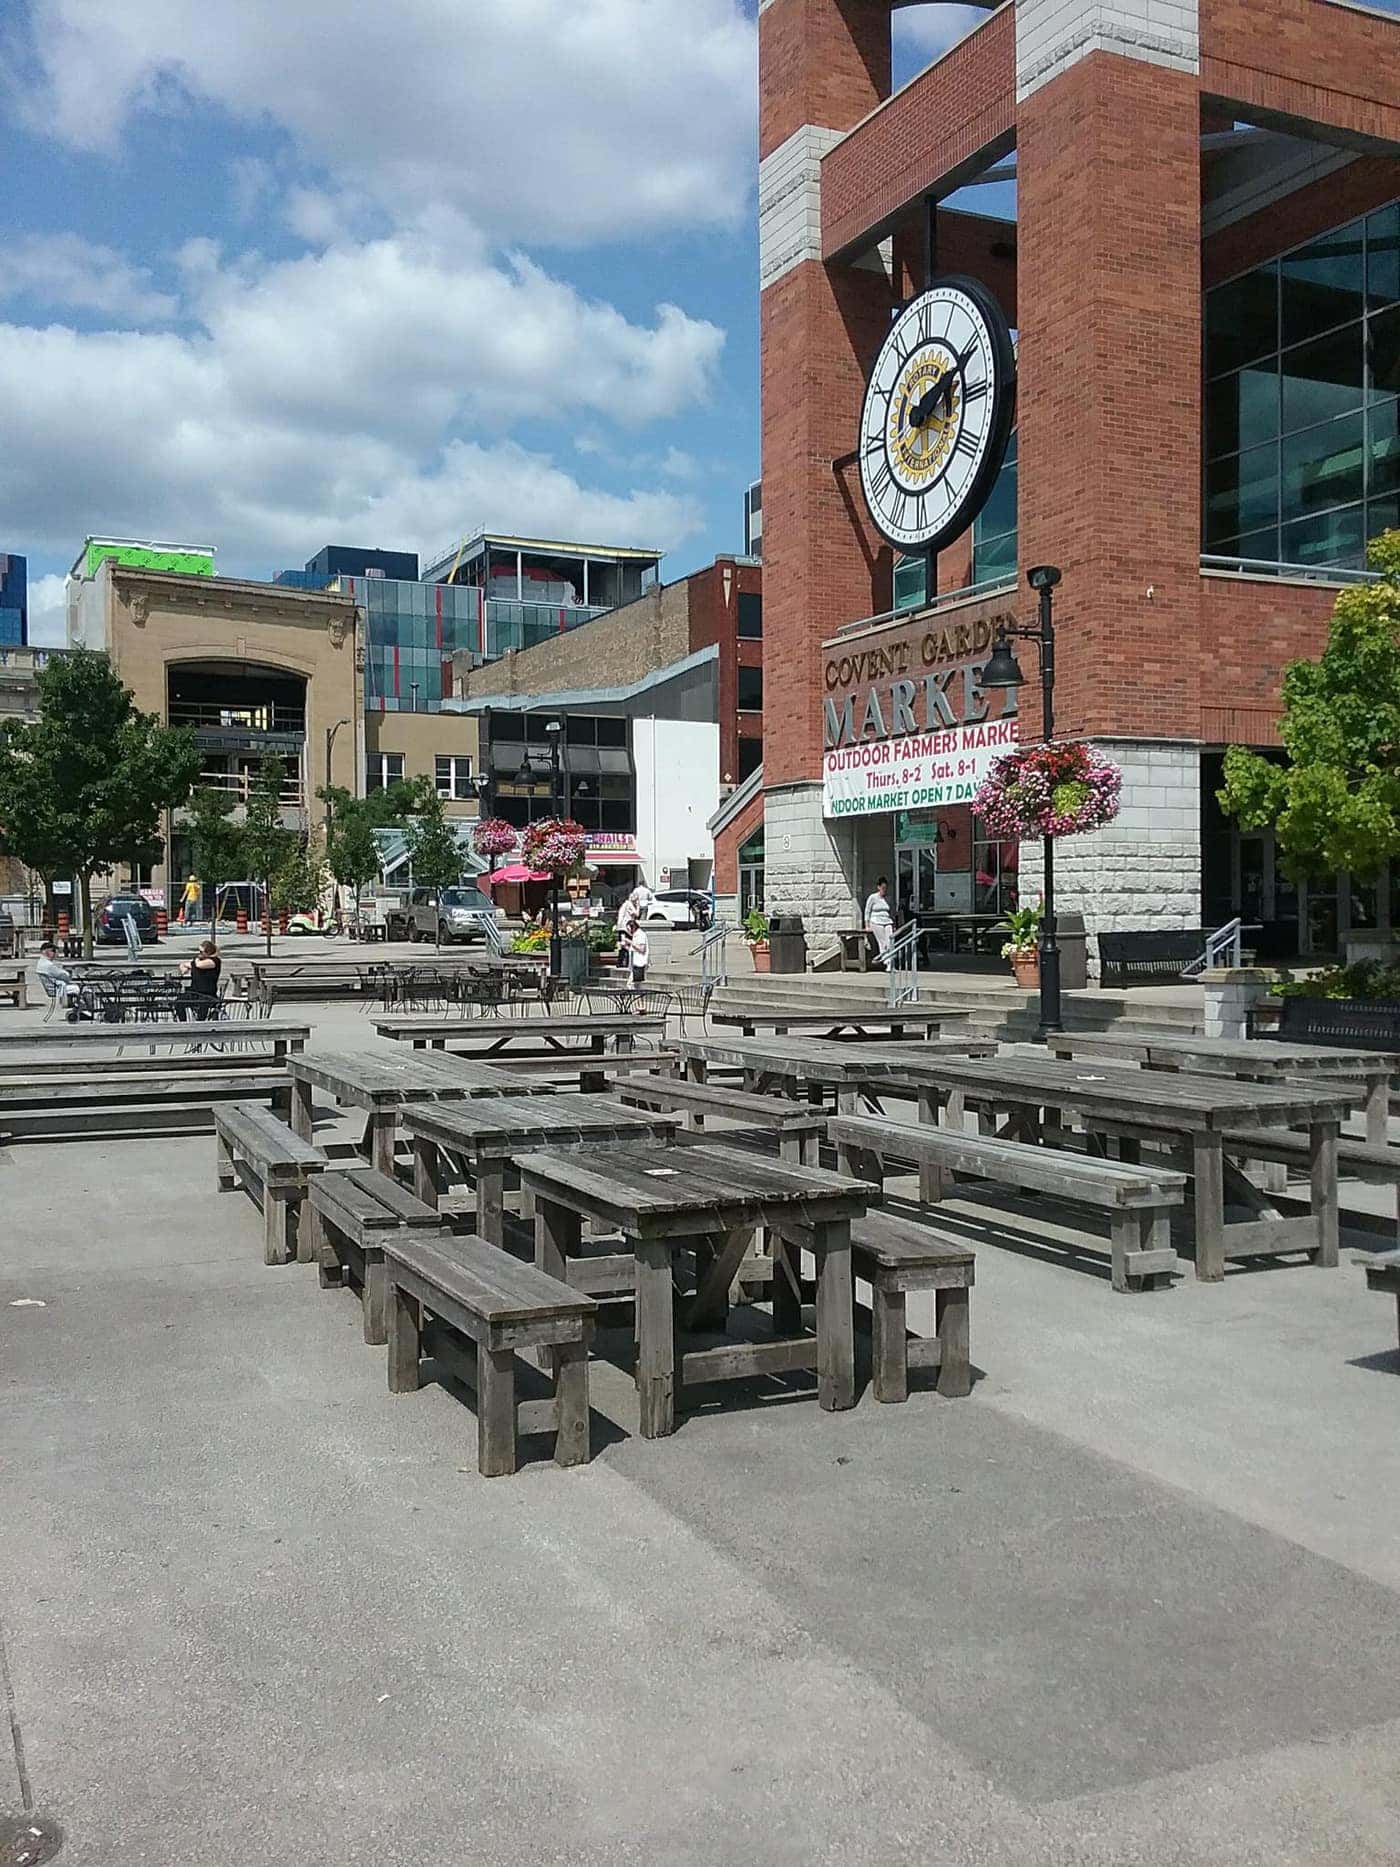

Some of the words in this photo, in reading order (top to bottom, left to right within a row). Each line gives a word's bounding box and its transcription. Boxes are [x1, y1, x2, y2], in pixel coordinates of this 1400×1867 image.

[906, 364, 938, 389] ROTARY
[825, 639, 911, 691] COVENT
[828, 745, 890, 772] OUTDOOR
[894, 732, 958, 762] FARMERS
[962, 720, 1020, 750] MARKE
[866, 771, 900, 789] Thurs.
[902, 767, 922, 784] 8-2
[931, 762, 954, 779] Sat.
[958, 758, 976, 777] 8-1
[867, 791, 909, 809] MARKET
[912, 786, 943, 805] OPEN
[946, 786, 953, 801] 7
